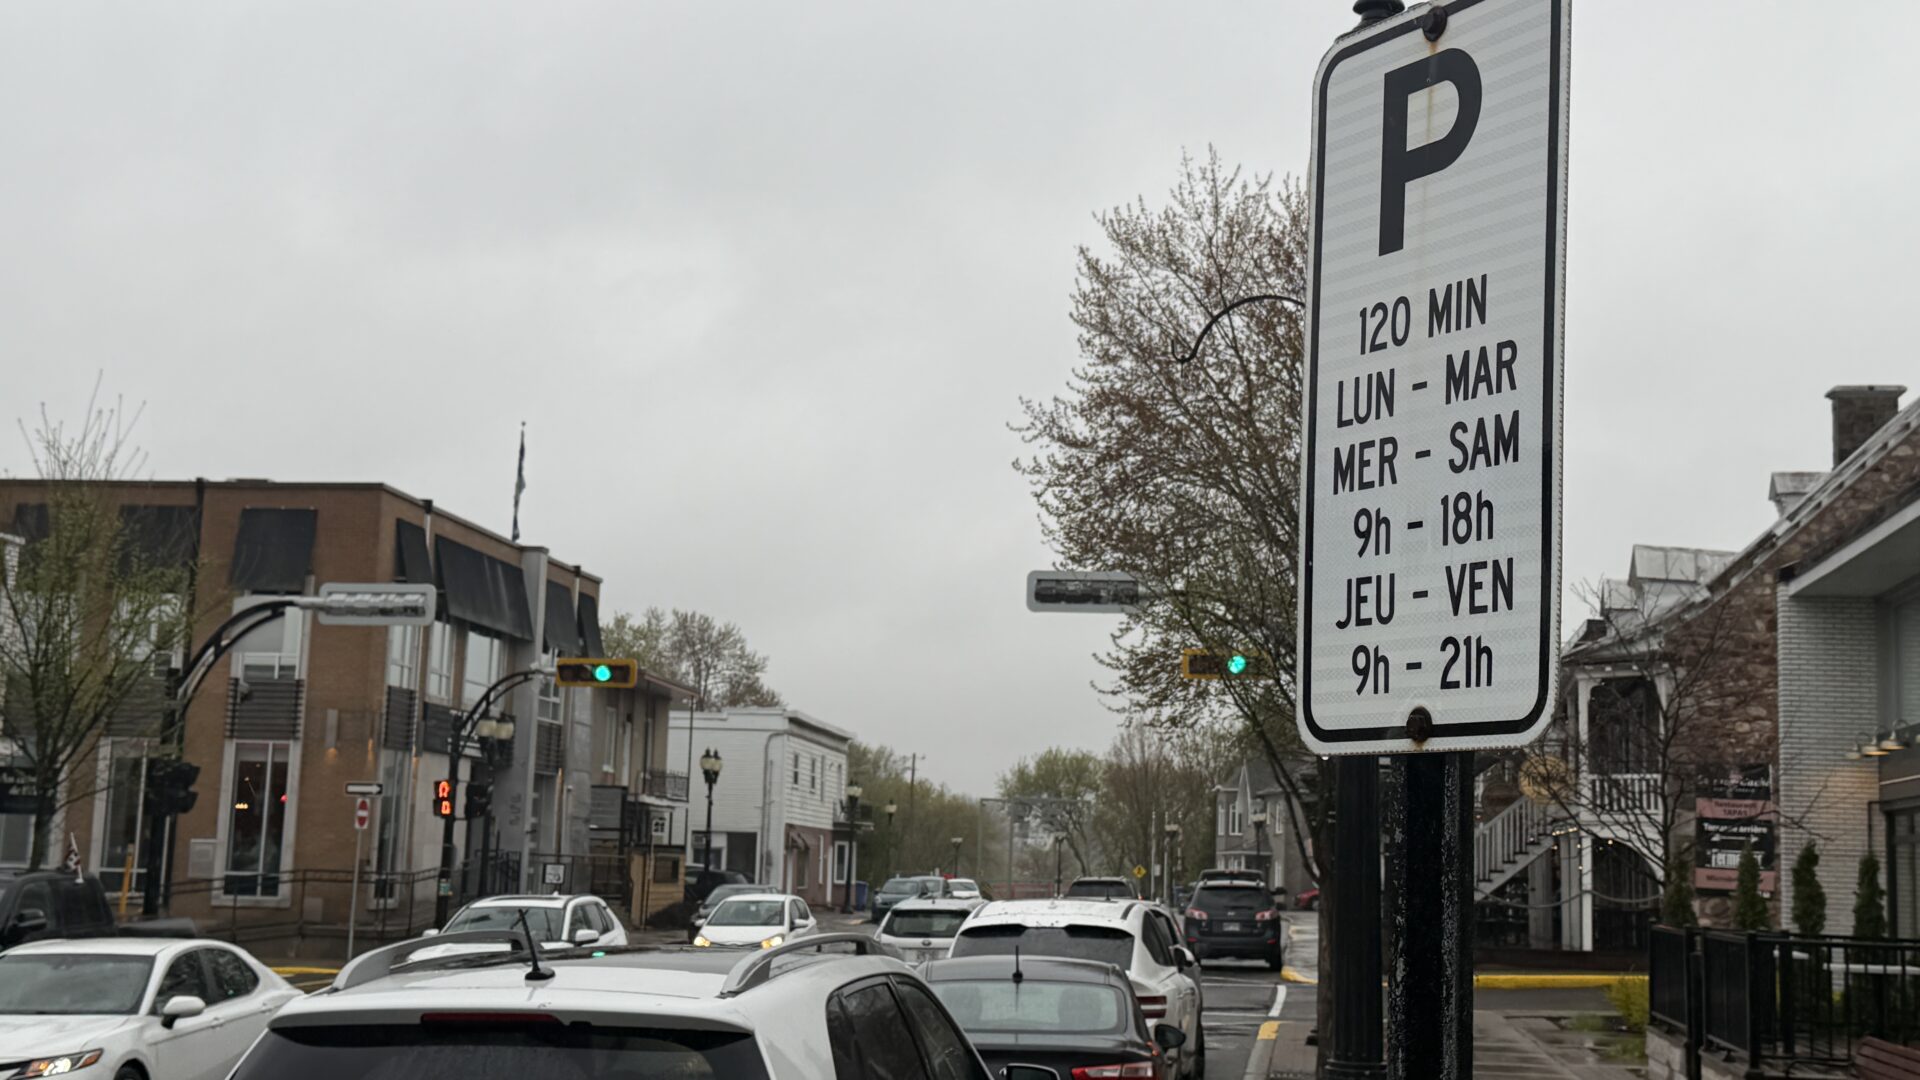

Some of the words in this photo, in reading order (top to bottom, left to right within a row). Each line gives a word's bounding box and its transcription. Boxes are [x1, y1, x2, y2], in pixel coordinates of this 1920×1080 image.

[1378, 47, 1483, 257] P
[1359, 295, 1411, 356] 120
[1427, 273, 1488, 339] MIN
[1336, 367, 1395, 429] LUN
[1411, 380, 1428, 392] -
[1445, 339, 1518, 406] MAR
[1332, 436, 1399, 496] MER
[1414, 449, 1432, 460] -
[1448, 409, 1520, 474] SAM
[1353, 507, 1391, 559] 9h
[1407, 520, 1424, 530] -
[1440, 489, 1494, 547] 18h
[1335, 572, 1396, 630] JEU
[1412, 589, 1429, 600] -
[1444, 556, 1514, 617] VEN
[1351, 644, 1390, 696] 9h
[1405, 661, 1423, 671] -
[1439, 634, 1493, 691] 21h
